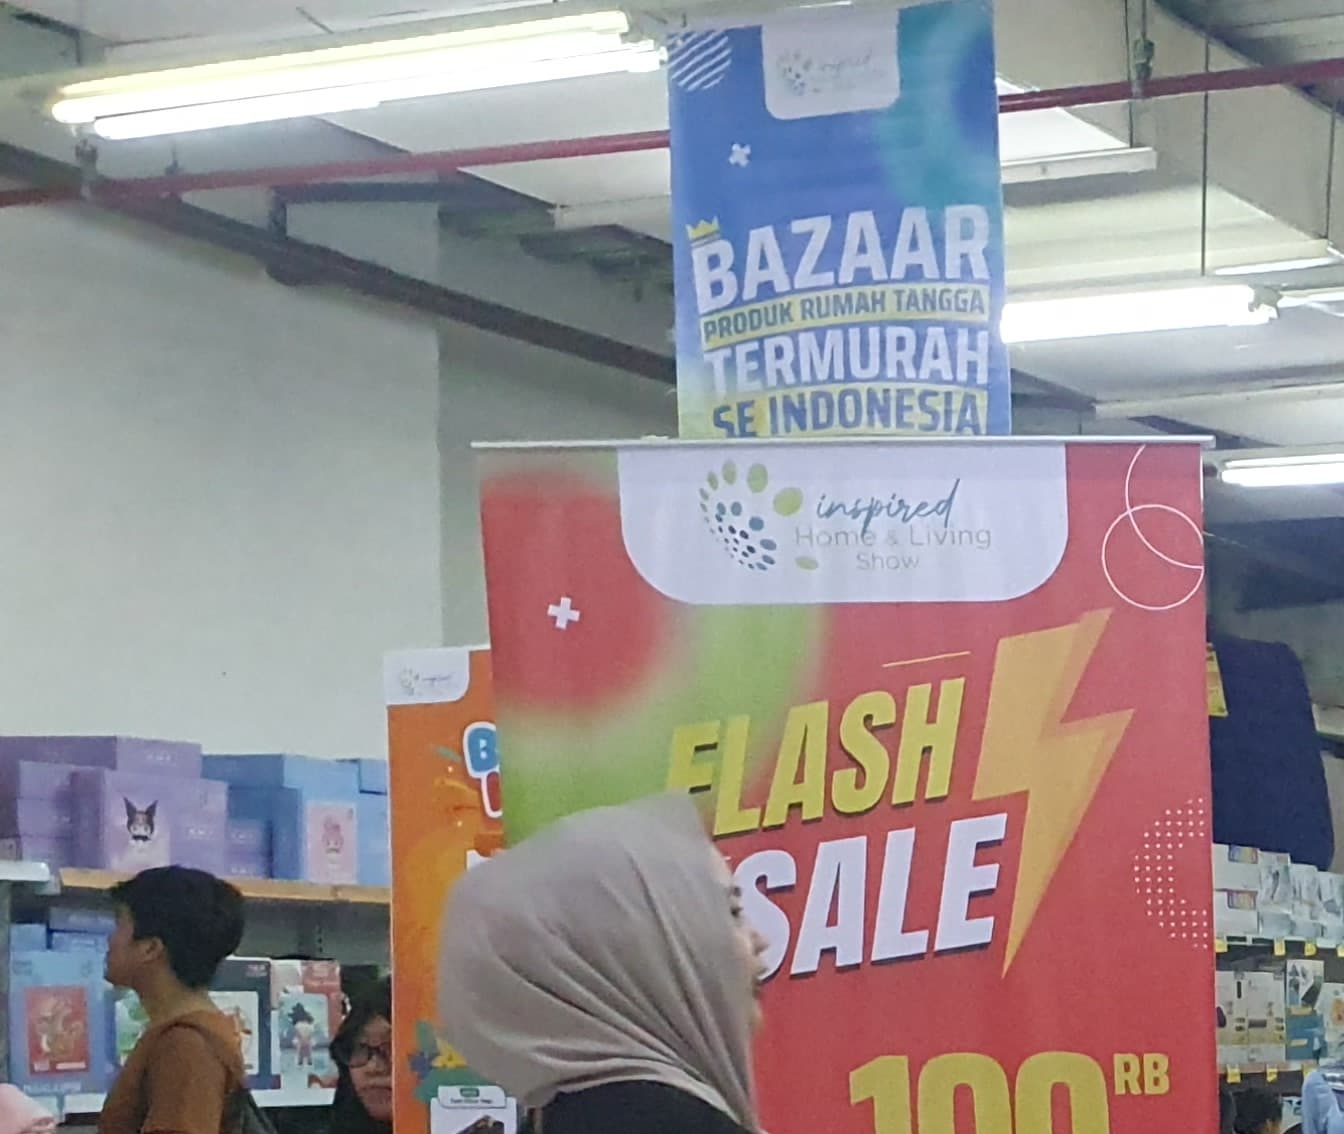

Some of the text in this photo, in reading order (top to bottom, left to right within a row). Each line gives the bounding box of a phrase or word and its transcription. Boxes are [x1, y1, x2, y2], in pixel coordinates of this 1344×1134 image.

[690, 203, 990, 314] BAZAAR
[703, 287, 986, 342] PRODUK RUMAH TANGGA
[703, 326, 990, 397] TERMURAH
[712, 387, 982, 438] SE INDONESIA
[815, 477, 960, 537] inspired
[795, 526, 993, 549] Home & Living
[855, 553, 921, 571] Show
[665, 676, 966, 837] FLASH
[732, 812, 1008, 984] SALE
[1114, 1053, 1170, 1097] RB
